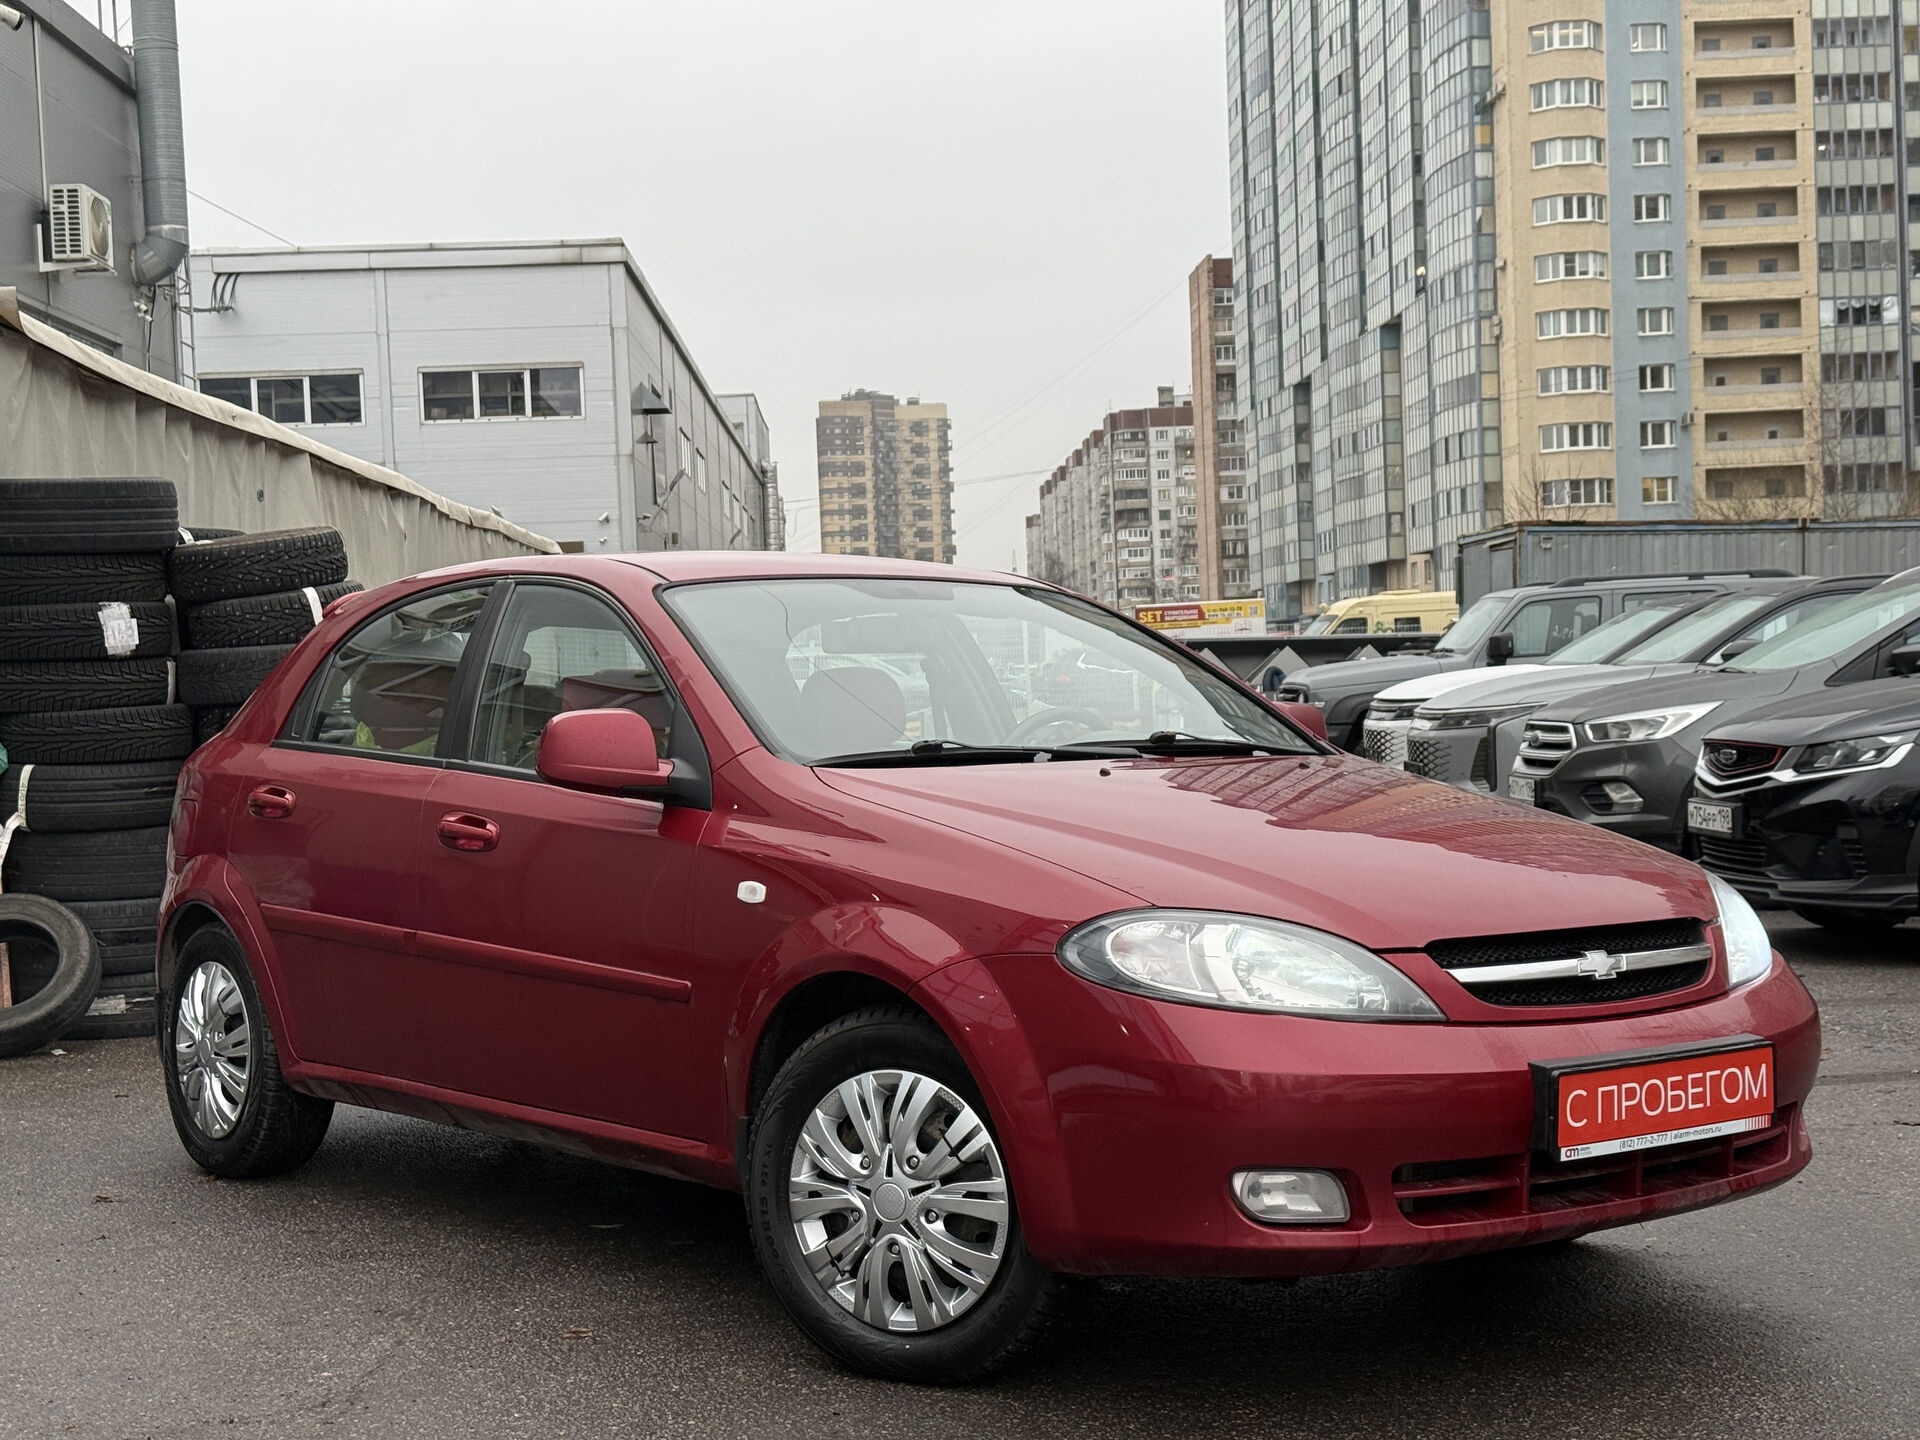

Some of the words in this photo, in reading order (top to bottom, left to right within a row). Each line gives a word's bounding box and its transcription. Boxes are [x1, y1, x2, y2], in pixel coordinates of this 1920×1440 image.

[1139, 610, 1163, 623] SET
[1566, 1089, 1588, 1128] С
[1597, 1063, 1767, 1124] ПРОБЕГОМ
[1619, 1138, 1635, 1151] (812)
[1636, 1133, 1668, 1147] 777-2-777
[1673, 1126, 1722, 1140] alarm-motors.ru
